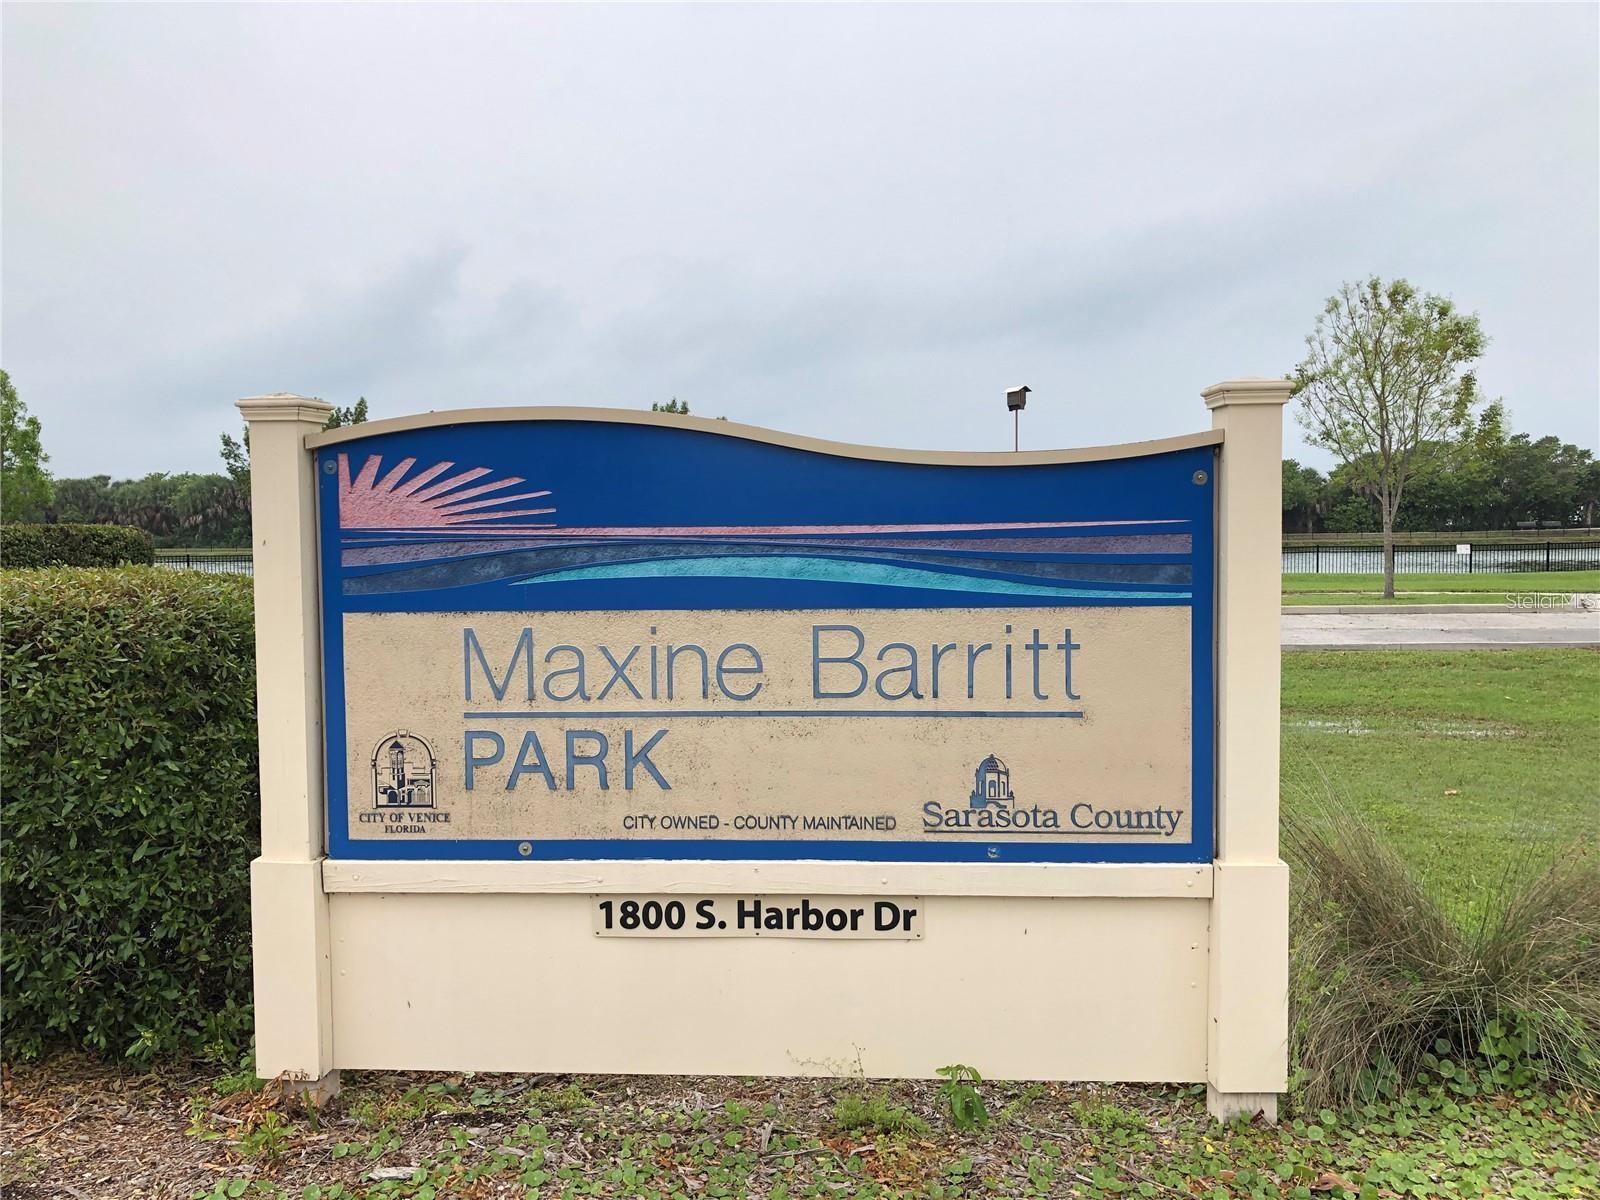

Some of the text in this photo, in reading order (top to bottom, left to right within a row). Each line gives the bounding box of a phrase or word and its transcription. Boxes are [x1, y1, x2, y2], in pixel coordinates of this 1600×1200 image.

[463, 624, 1081, 701] Maxine Barritt
[464, 729, 672, 790] PARK
[359, 813, 451, 823] CITY OF VENICE
[385, 825, 426, 833] FLORIDA
[622, 816, 657, 829] CITY
[660, 815, 720, 829] OWNED
[733, 815, 799, 830] COUNTY
[802, 816, 897, 830] MAINTAINED
[922, 801, 1184, 836] Sarasota County
[599, 899, 918, 931] 1800 S. Harbor Dr
